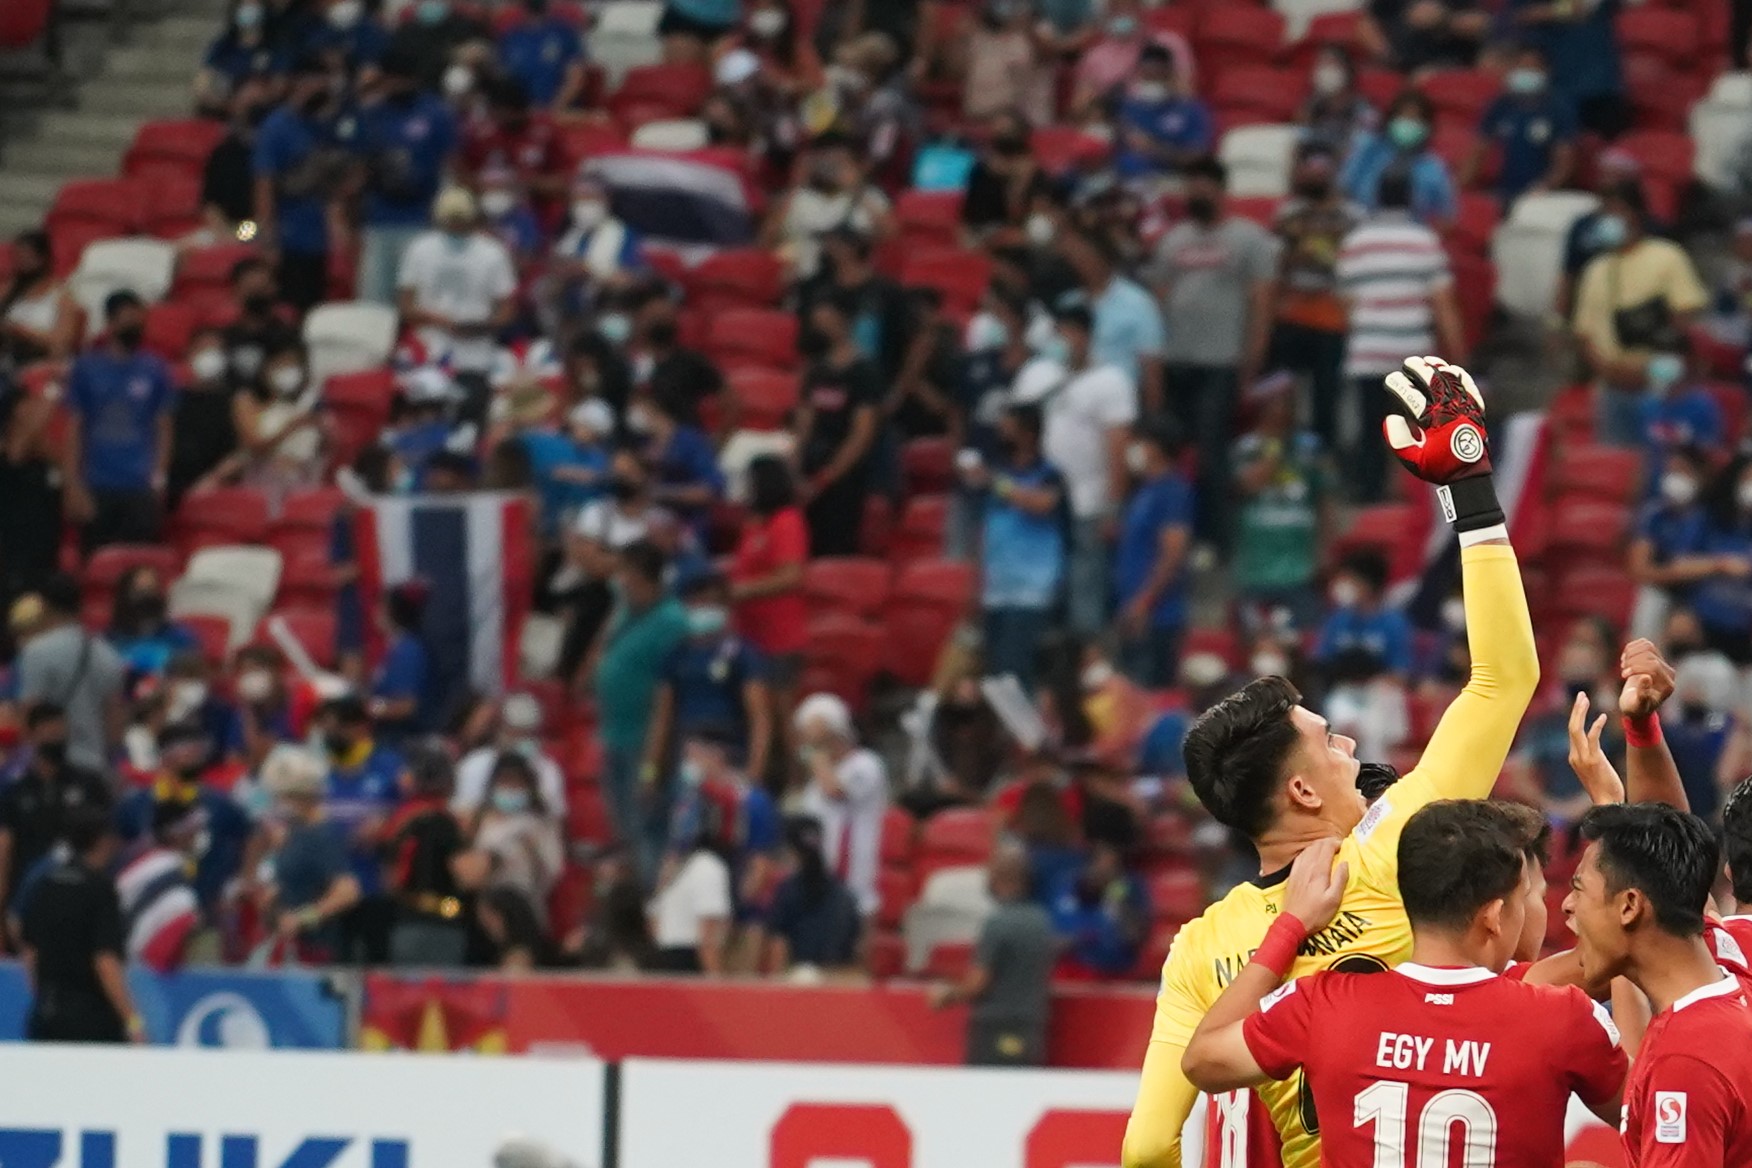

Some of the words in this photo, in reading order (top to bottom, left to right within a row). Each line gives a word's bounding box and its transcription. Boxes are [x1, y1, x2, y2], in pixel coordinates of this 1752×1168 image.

[1424, 993, 1455, 1005] PSSI
[1376, 1031, 1435, 1071] EGY
[1443, 1038, 1492, 1078] MV
